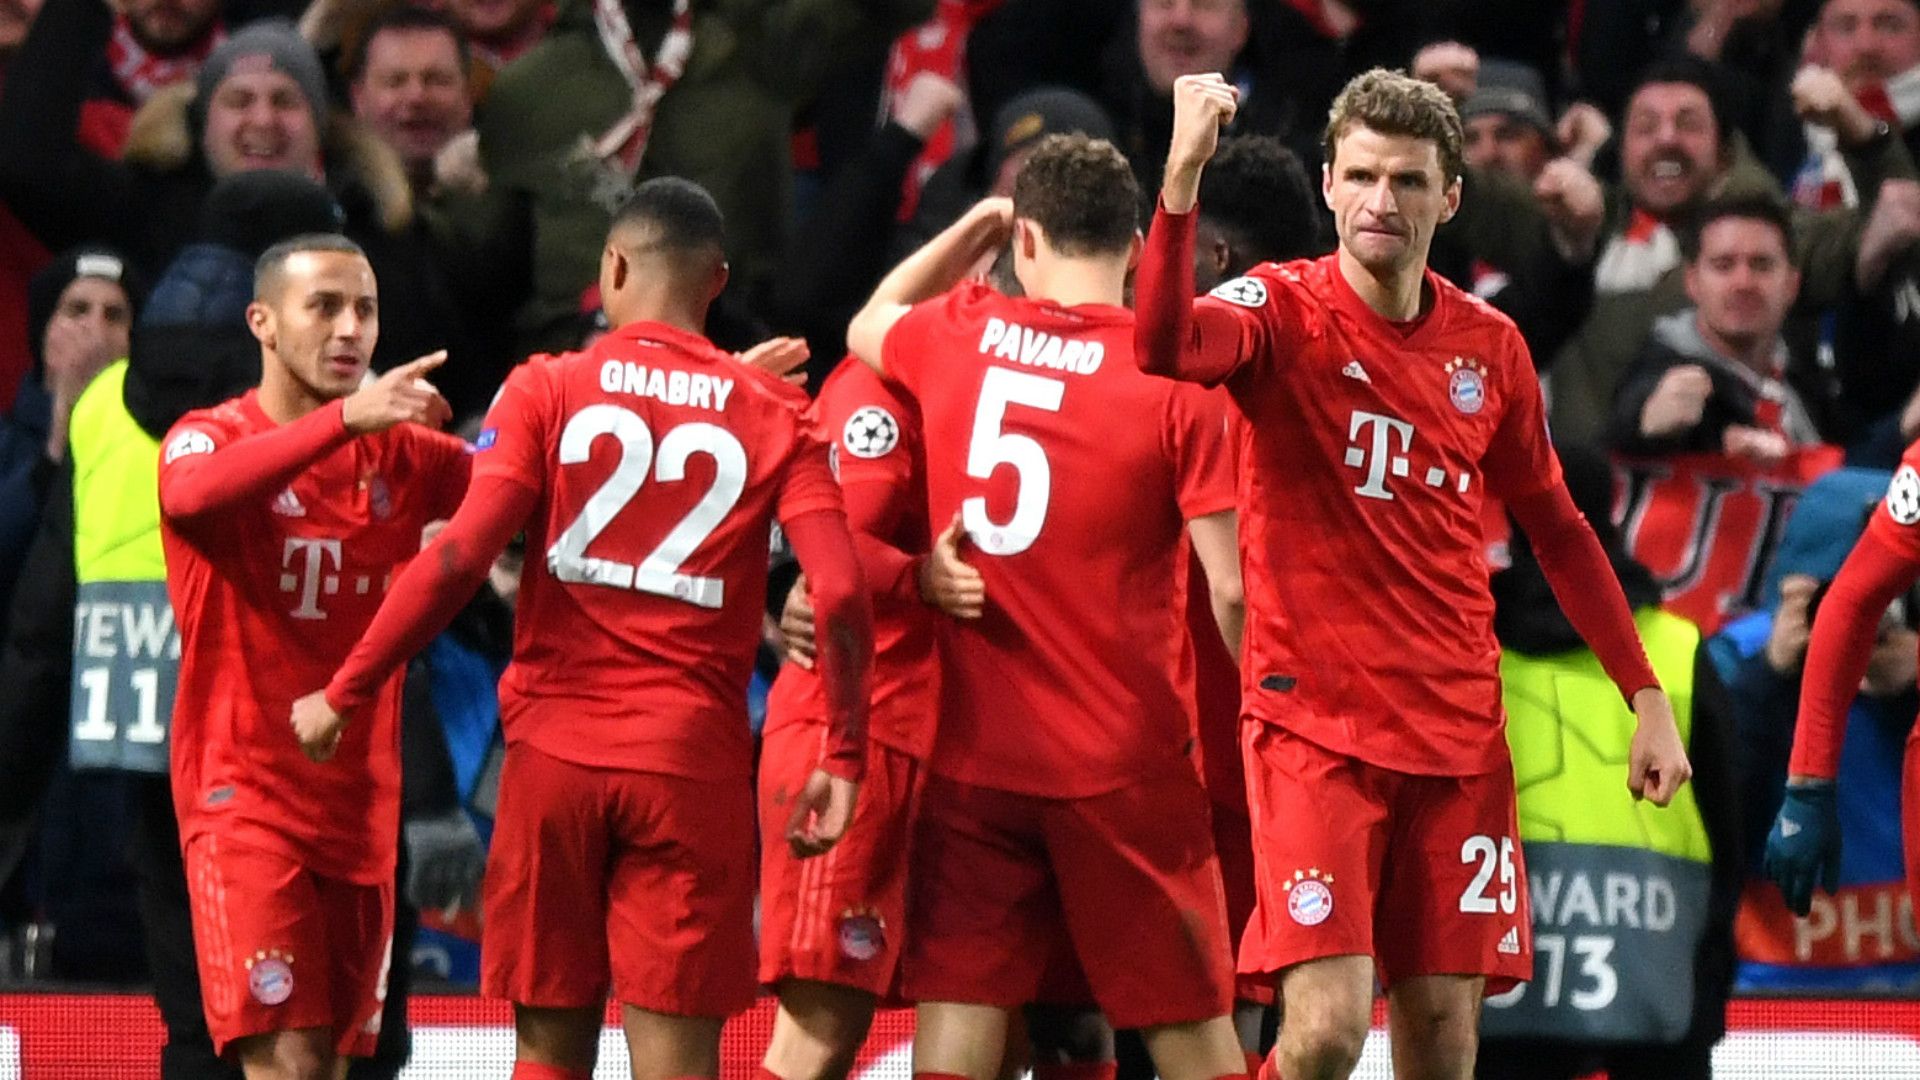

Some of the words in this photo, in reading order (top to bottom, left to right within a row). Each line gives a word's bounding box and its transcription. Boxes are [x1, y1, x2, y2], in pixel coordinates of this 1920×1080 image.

[979, 316, 1104, 375] PAVARD
[599, 359, 734, 412] GNABRY
[962, 365, 1065, 556] 5
[547, 403, 747, 609] 22
[74, 666, 166, 743] 11
[1459, 835, 1517, 915] 25
